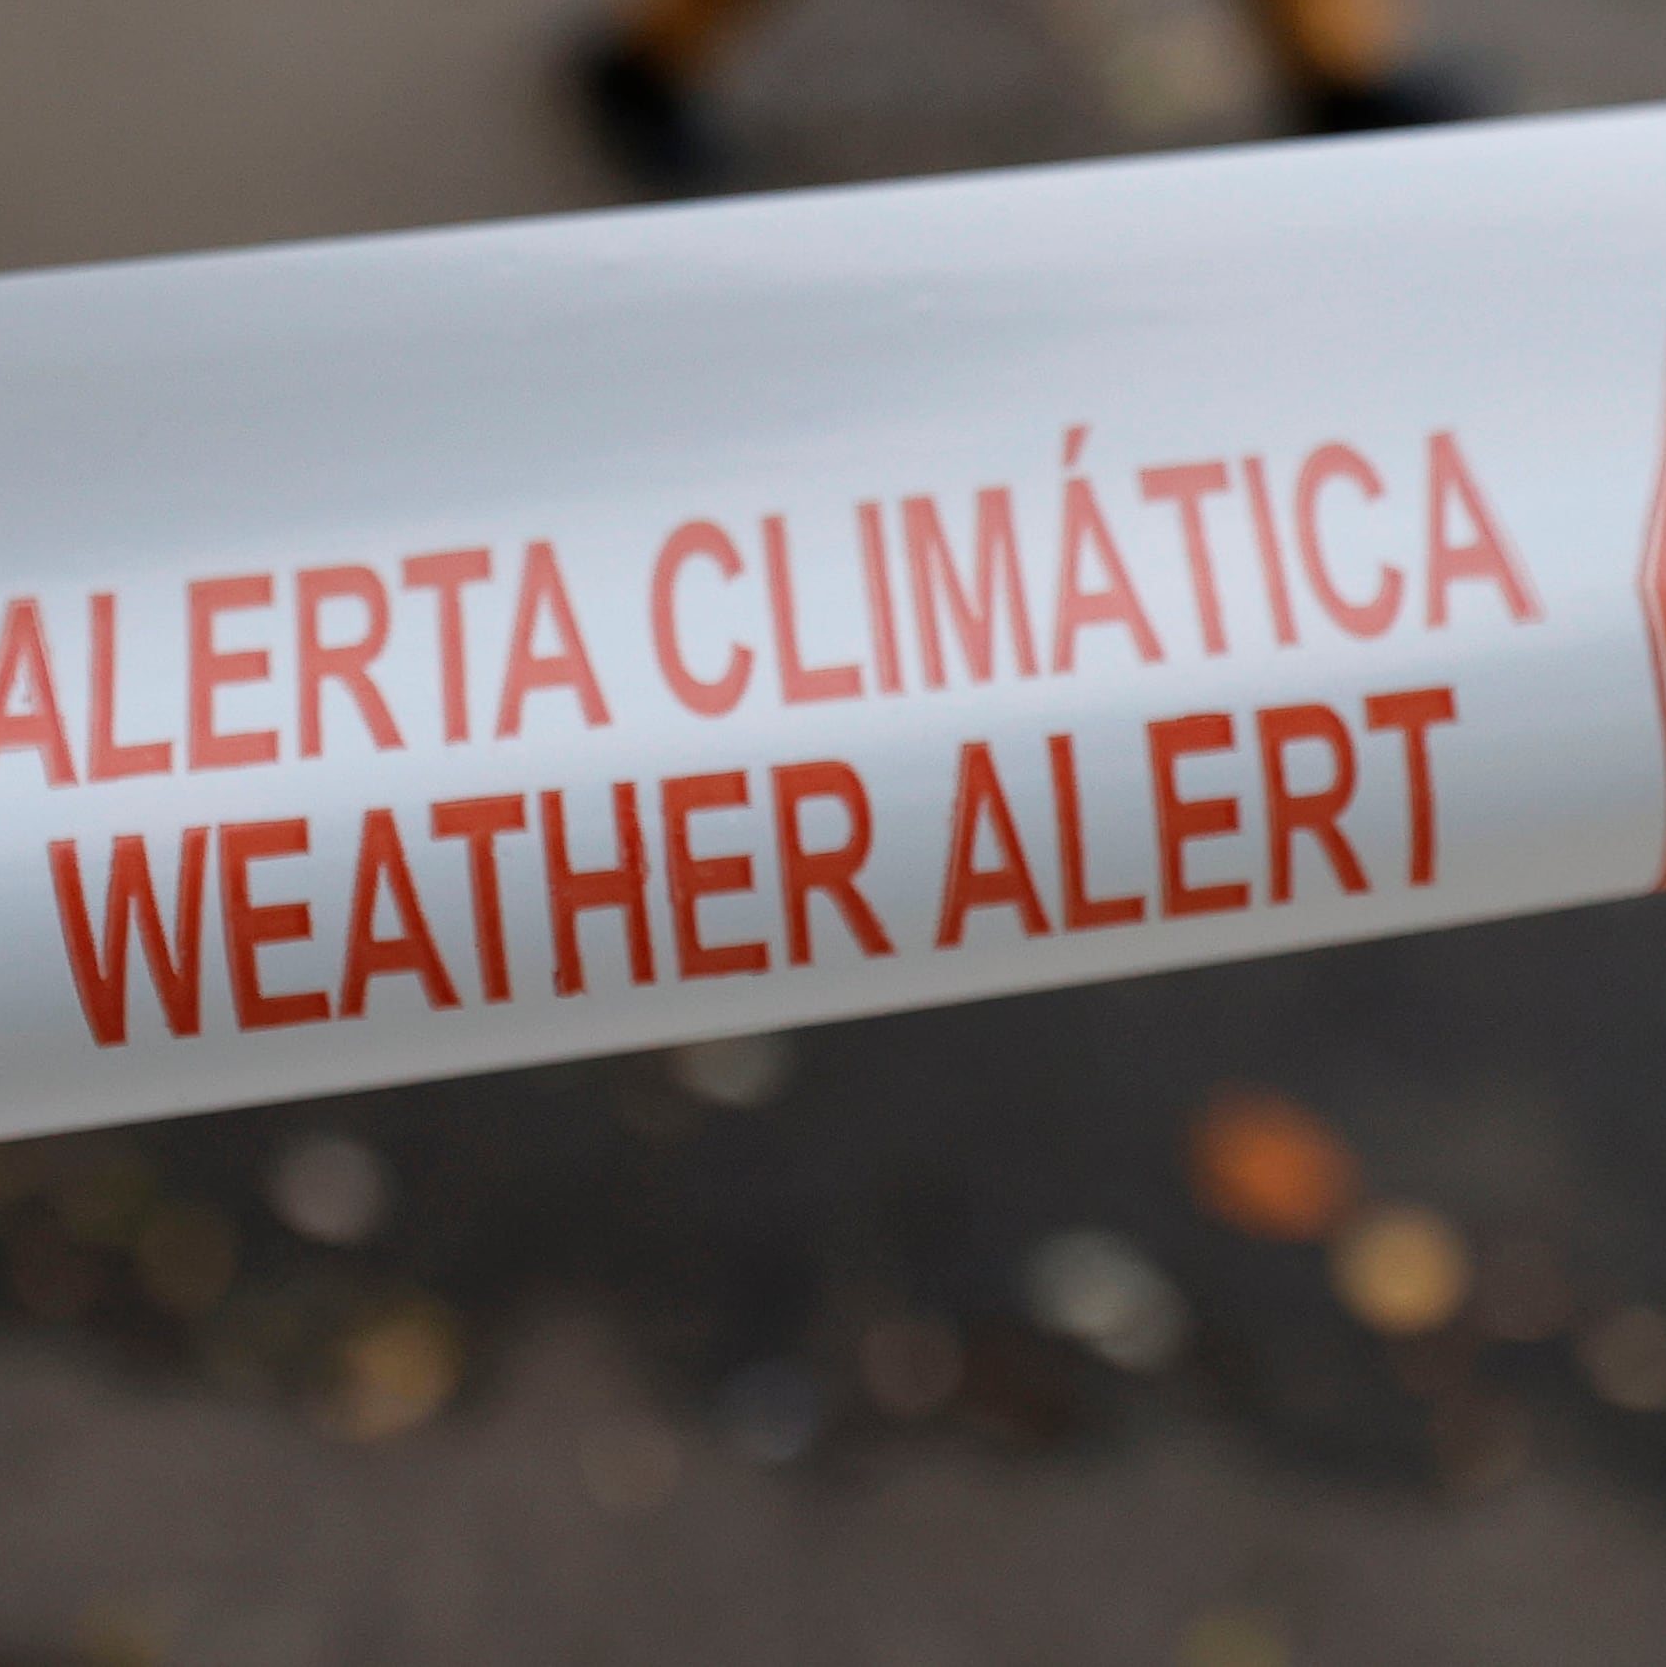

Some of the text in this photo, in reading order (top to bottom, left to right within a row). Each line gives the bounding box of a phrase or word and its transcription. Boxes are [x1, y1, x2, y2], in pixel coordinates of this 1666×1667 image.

[649, 424, 1543, 716] CLIMÁTICA
[48, 686, 1457, 1049] WEATHER ALERT
